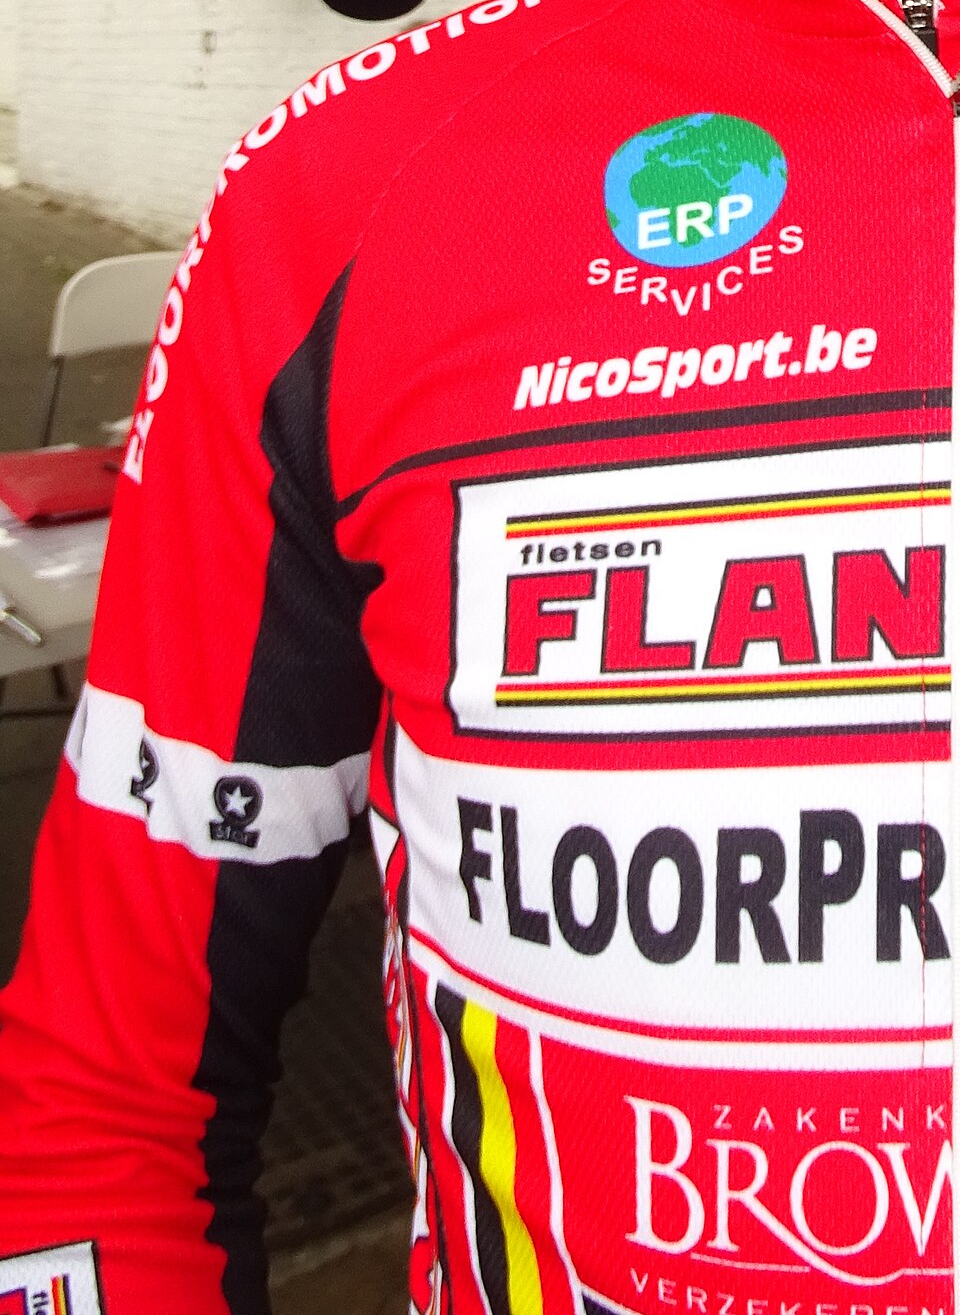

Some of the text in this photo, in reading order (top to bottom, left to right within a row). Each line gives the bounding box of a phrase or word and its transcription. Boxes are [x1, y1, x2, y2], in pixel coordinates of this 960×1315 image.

[636, 193, 754, 251] ERP
[586, 225, 805, 317] SERVICES
[512, 324, 879, 412] NicoSport.be
